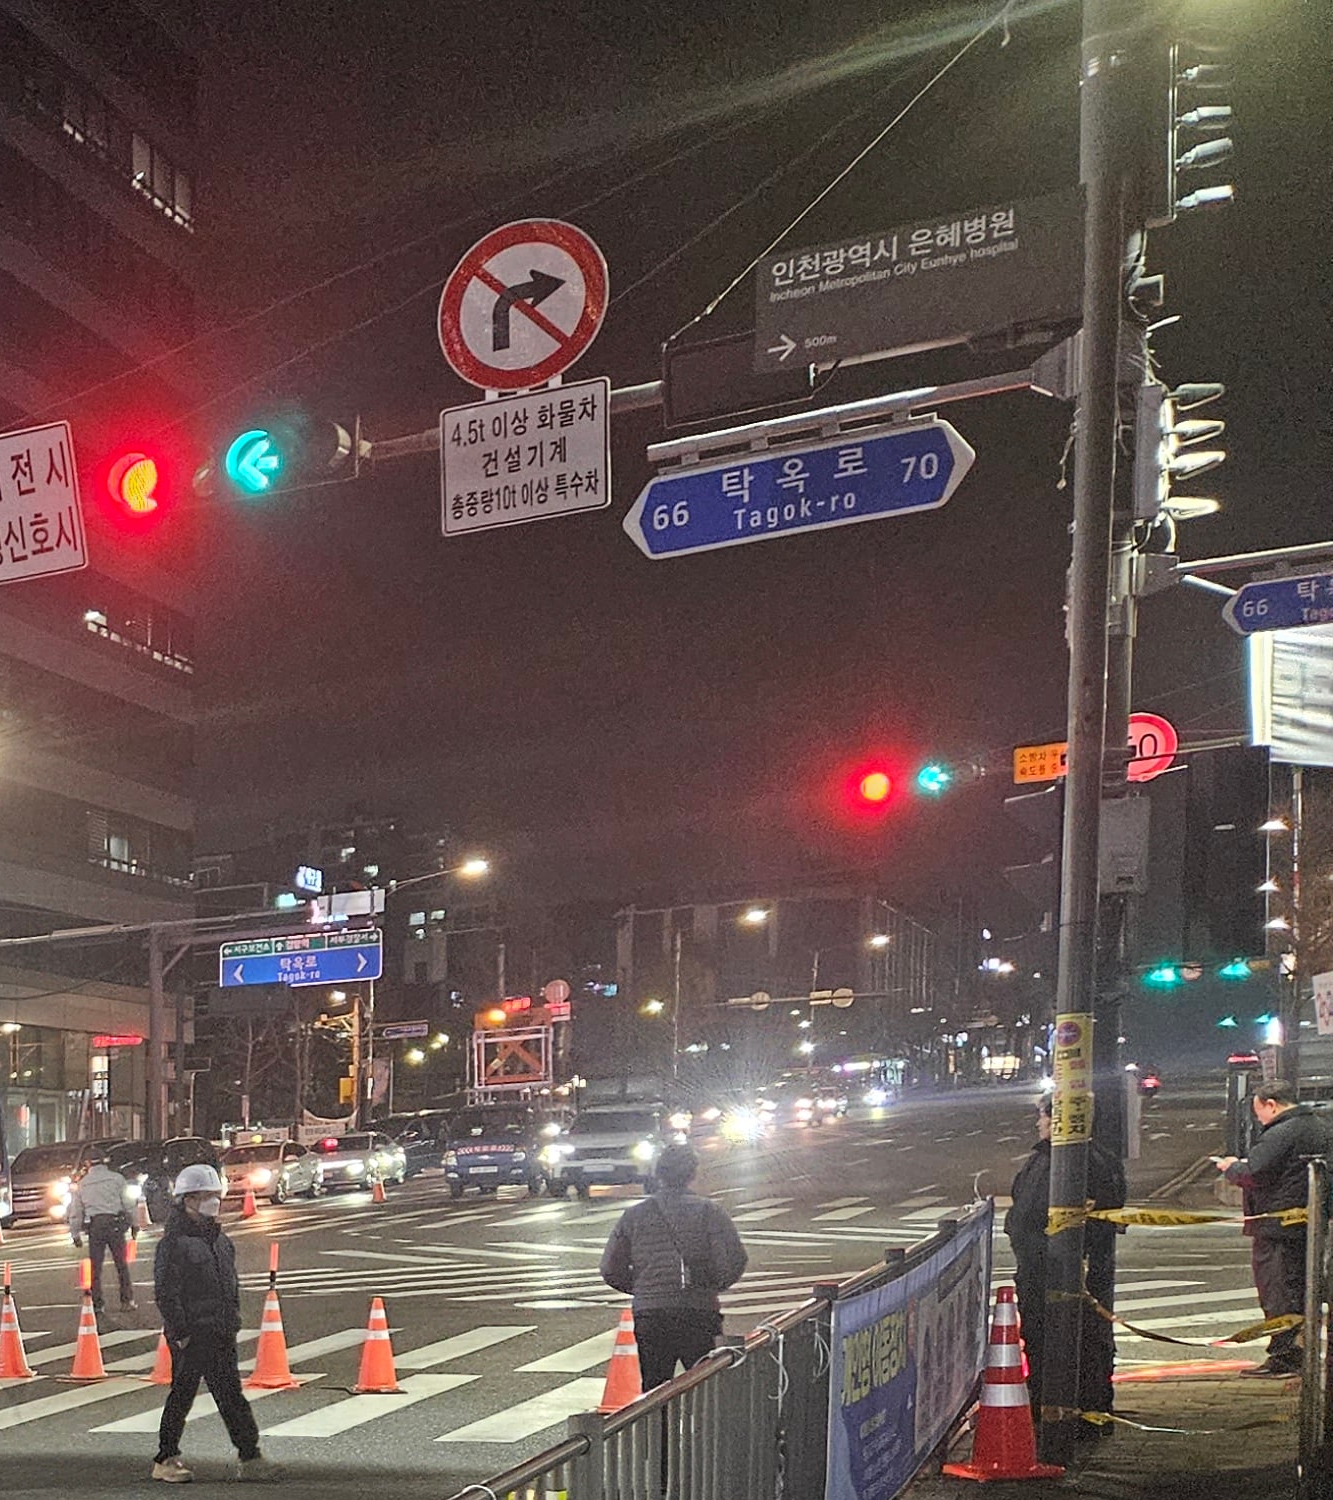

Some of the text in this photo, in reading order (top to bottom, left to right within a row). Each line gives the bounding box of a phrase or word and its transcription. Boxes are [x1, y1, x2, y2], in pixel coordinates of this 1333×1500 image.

[768, 280, 816, 303] Incheon
[818, 266, 891, 296] Metropolitan
[893, 261, 918, 284] City
[969, 239, 1019, 268] hospital
[770, 208, 1017, 288] 인천광역시 은혜병원
[804, 334, 838, 349] 500m
[450, 393, 598, 449] 4.5t 이상 화물차
[480, 437, 569, 480] 건설기계
[450, 469, 601, 522] 총중량10t 이상 특수차
[651, 501, 691, 532] 66
[899, 453, 940, 484] 70
[732, 489, 857, 534] Tagok-ro
[1242, 599, 1269, 617] 66
